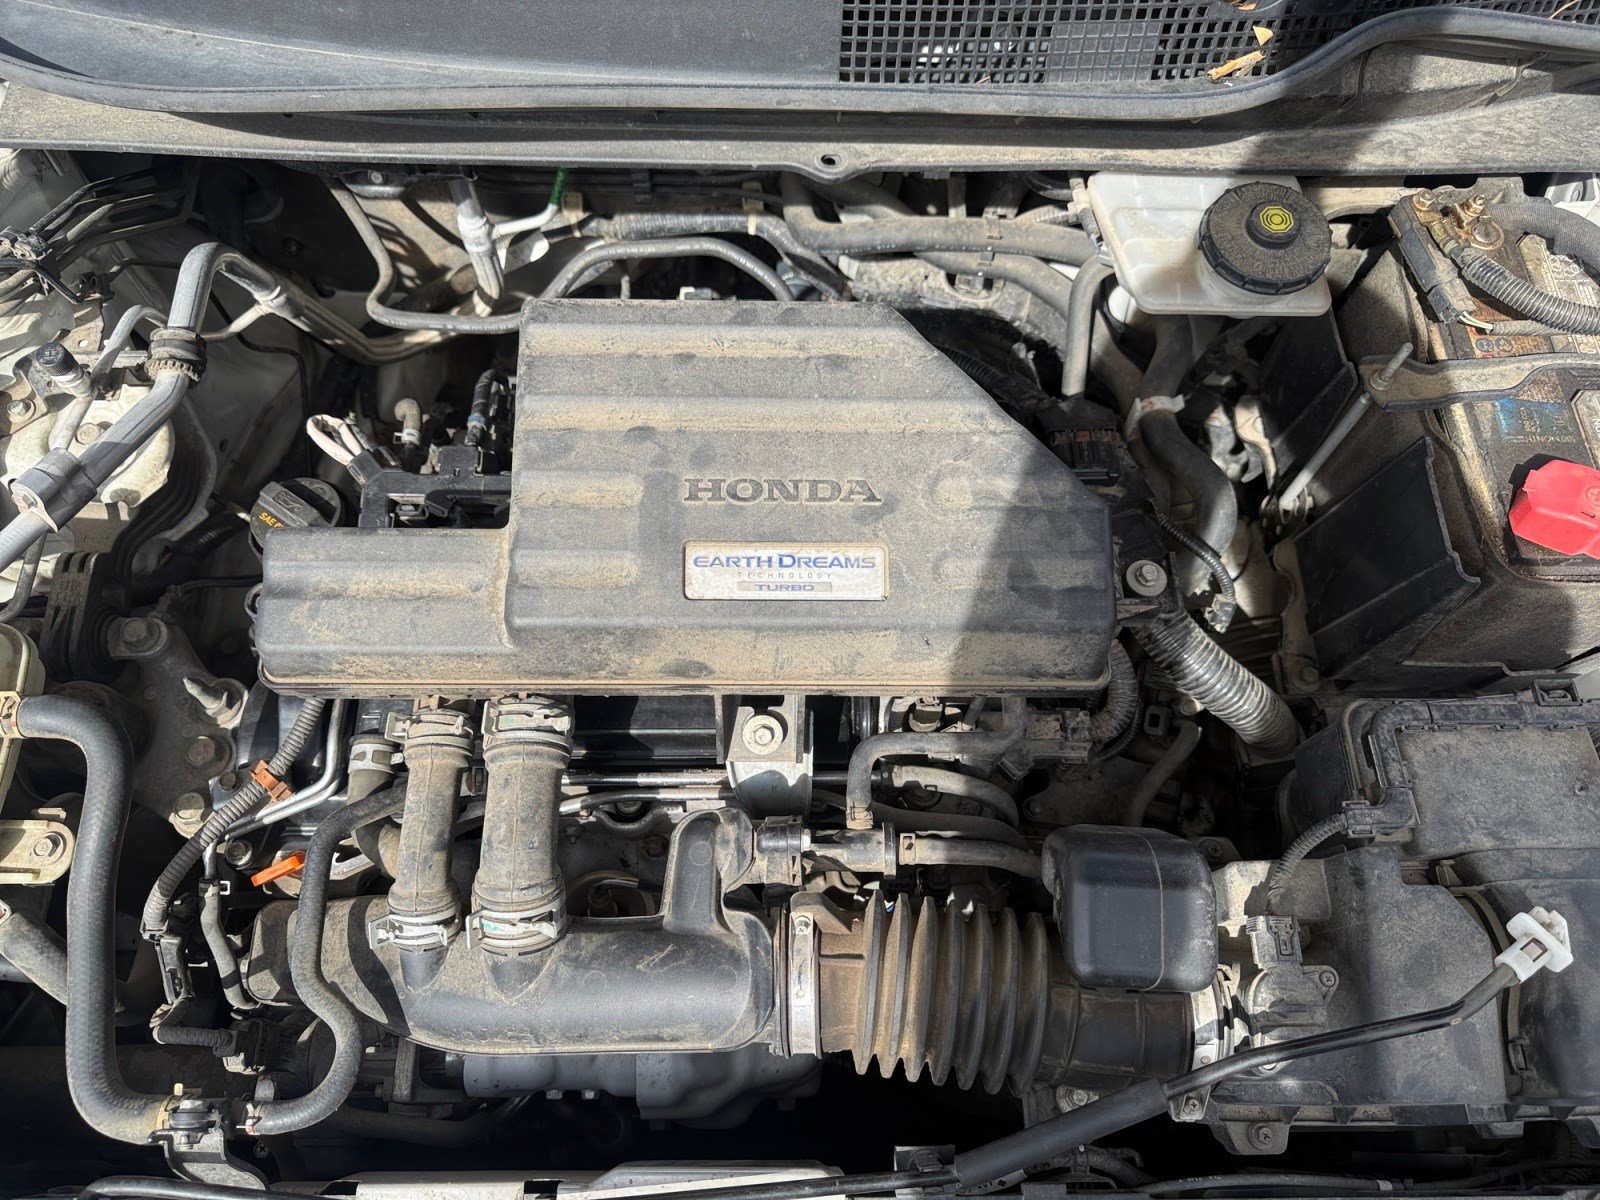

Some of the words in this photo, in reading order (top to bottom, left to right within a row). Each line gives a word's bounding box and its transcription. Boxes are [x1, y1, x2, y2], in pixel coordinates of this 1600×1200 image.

[683, 478, 882, 502] HONDA
[259, 512, 277, 526] SAE
[692, 555, 773, 568] EARTH
[778, 553, 876, 569] DREAMS
[737, 571, 833, 579] TECHNOLOGY
[754, 583, 815, 592] TURBO
